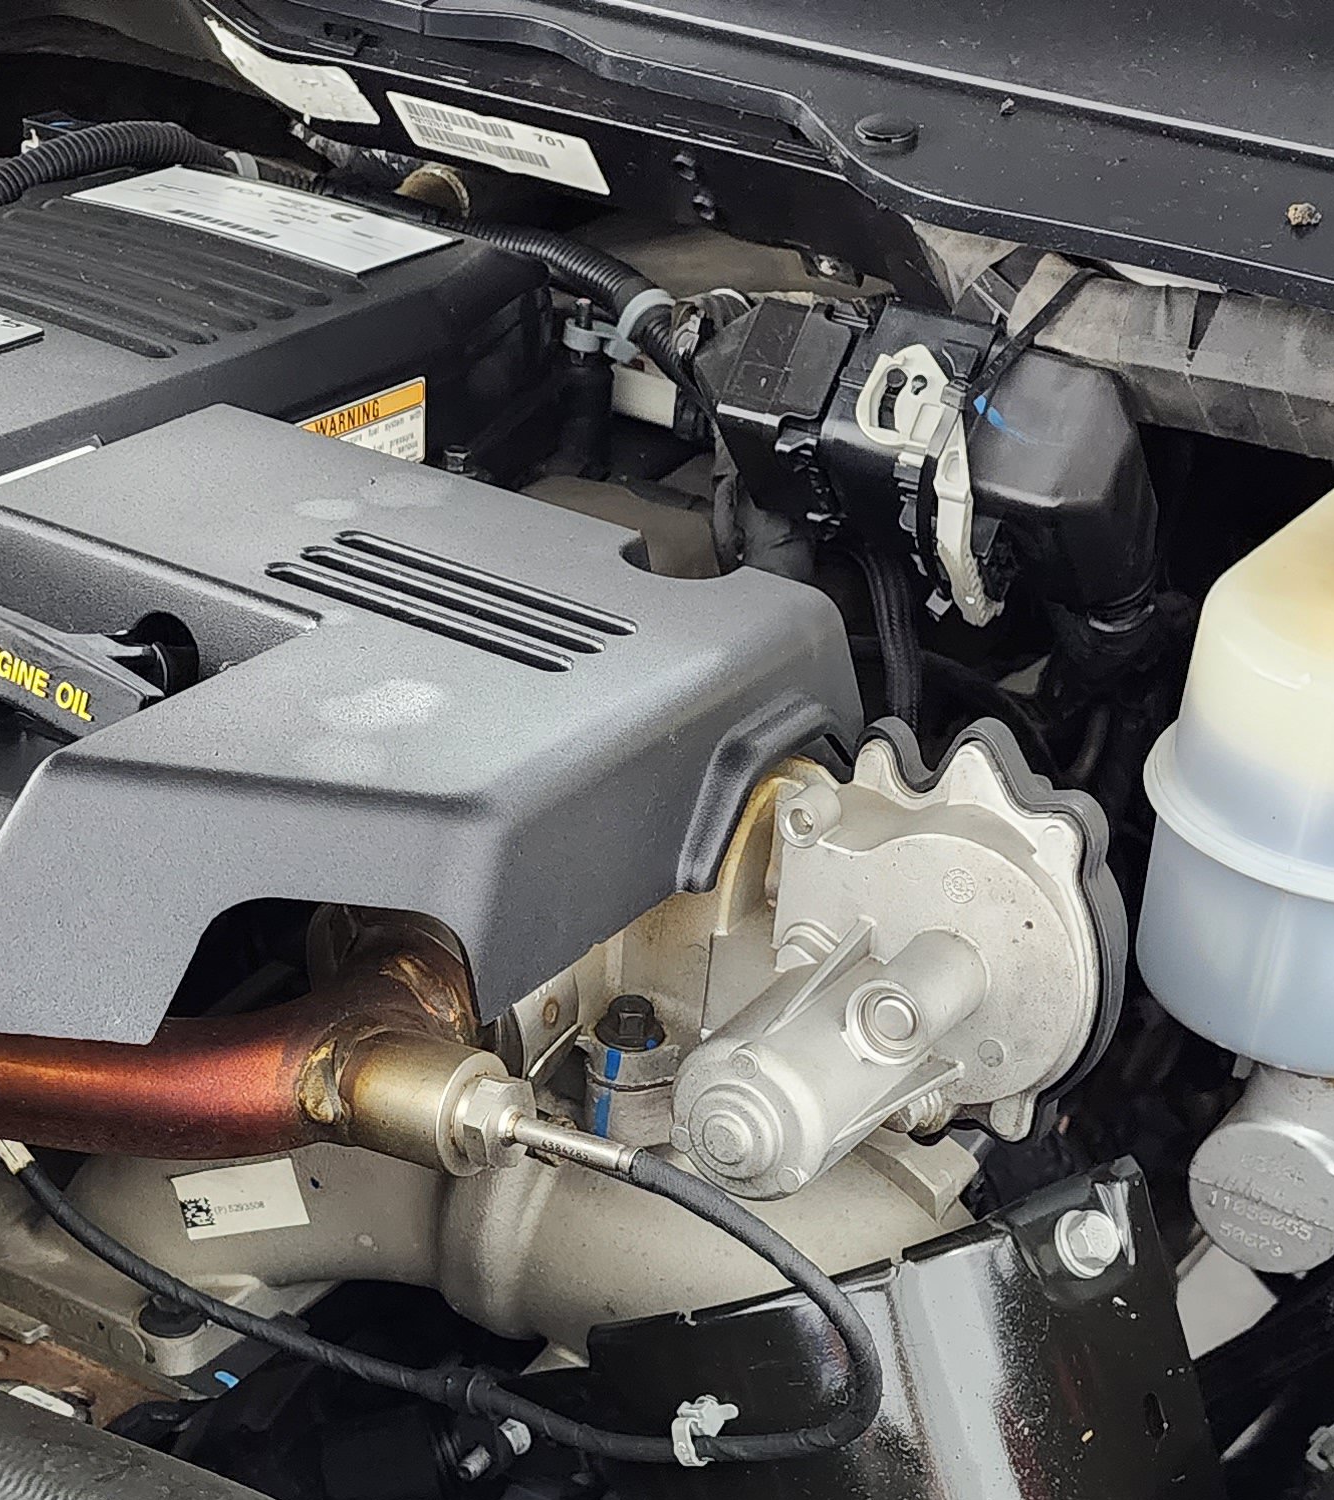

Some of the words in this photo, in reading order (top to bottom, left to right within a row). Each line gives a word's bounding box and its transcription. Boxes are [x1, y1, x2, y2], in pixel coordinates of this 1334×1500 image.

[532, 132, 566, 149] 701
[314, 399, 381, 437] WARNING
[54, 680, 95, 722] OIL
